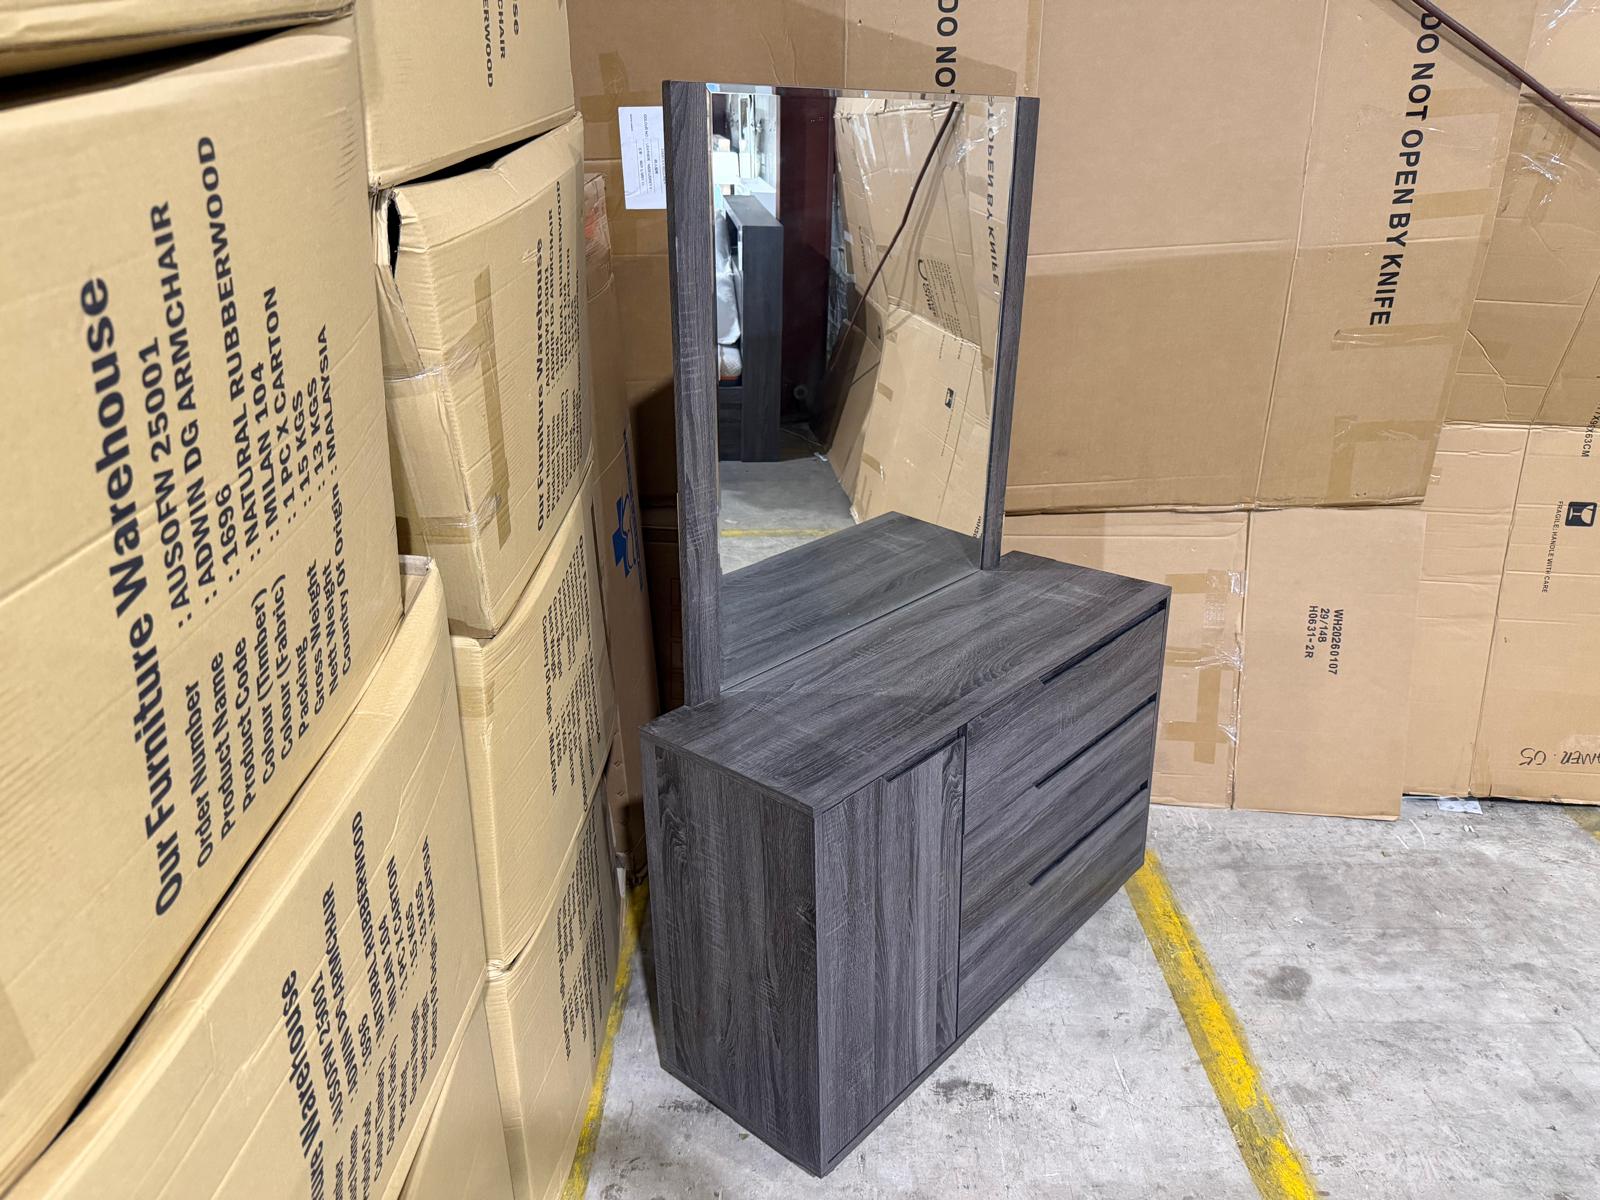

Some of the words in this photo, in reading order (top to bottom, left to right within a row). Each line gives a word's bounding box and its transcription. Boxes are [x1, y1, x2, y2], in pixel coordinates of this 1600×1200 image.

[937, 0, 959, 37] DO
[1416, 13, 1442, 54] DO
[935, 46, 957, 94] NO
[1405, 62, 1436, 122] NOT
[1391, 129, 1424, 206] OPEN
[1385, 212, 1411, 249] BY
[198, 137, 245, 401] RUBBERWOOD
[1369, 254, 1404, 327] KNIFE
[150, 202, 196, 411] ARMCHAIR
[264, 286, 286, 414] CARTON
[138, 337, 171, 462] 25001
[251, 362, 268, 424] 104
[276, 416, 289, 442] X
[292, 390, 307, 452] KGS
[307, 377, 320, 437] KGS
[318, 324, 336, 463] MALAYSIA
[81, 278, 147, 618] Warehouse
[181, 419, 202, 474] DG
[233, 403, 259, 548] NATURAL
[257, 430, 278, 529] MILAN
[279, 443, 293, 487] PC
[298, 454, 310, 492] 15
[313, 440, 324, 475] 13
[187, 476, 215, 587] ADWIN
[215, 484, 238, 565] 1696
[283, 487, 295, 508] 1
[331, 482, 343, 556] Origin
[1551, 500, 1564, 531] FRAGILE:
[153, 469, 190, 610] AUSOFW
[336, 558, 345, 587] Of
[1544, 557, 1554, 576] WITH
[1546, 531, 1558, 558] HANDLE
[307, 559, 321, 651] Weight
[322, 559, 336, 647] Weight
[1541, 575, 1550, 594] CARE
[251, 588, 273, 702] (Timber)
[271, 574, 291, 679] (Fabric)
[340, 589, 351, 676] Country
[1304, 605, 1319, 659] H0631-2R
[1317, 607, 1331, 643] 29/148
[1328, 608, 1344, 675] WH20260107
[211, 652, 228, 738] Name
[233, 637, 250, 710] Code
[295, 636, 309, 739] Packing
[314, 647, 324, 715] Gross
[328, 642, 338, 696] Nett
[129, 613, 175, 839] Furniture
[185, 681, 207, 795] Number
[261, 702, 275, 784] Colour
[280, 681, 293, 760] Colour
[1518, 747, 1547, 766] 05
[215, 732, 236, 840] Product
[237, 706, 256, 813] Product
[195, 791, 213, 868] Order
[156, 831, 182, 916] Our
[351, 811, 376, 961] RUBBERWOOD
[386, 855, 402, 936] CARTON
[415, 881, 426, 922] KGS
[422, 834, 437, 926] MALAYSIA
[322, 880, 346, 999] ARMCHAIR
[379, 913, 391, 956] 104
[395, 929, 404, 951] X
[405, 902, 417, 945] KGS
[409, 940, 418, 969] 15
[419, 919, 427, 946] 13
[367, 951, 386, 1043] NATURAL
[382, 951, 398, 1017] MILAN
[397, 946, 408, 980] PC
[310, 969, 332, 1047] 25001
[335, 997, 348, 1034] DG
[358, 1012, 373, 1068] 1696
[281, 970, 321, 1159] Warehouse
[320, 1037, 344, 1128] AUSOFW
[341, 1024, 359, 1097] ADWIN
